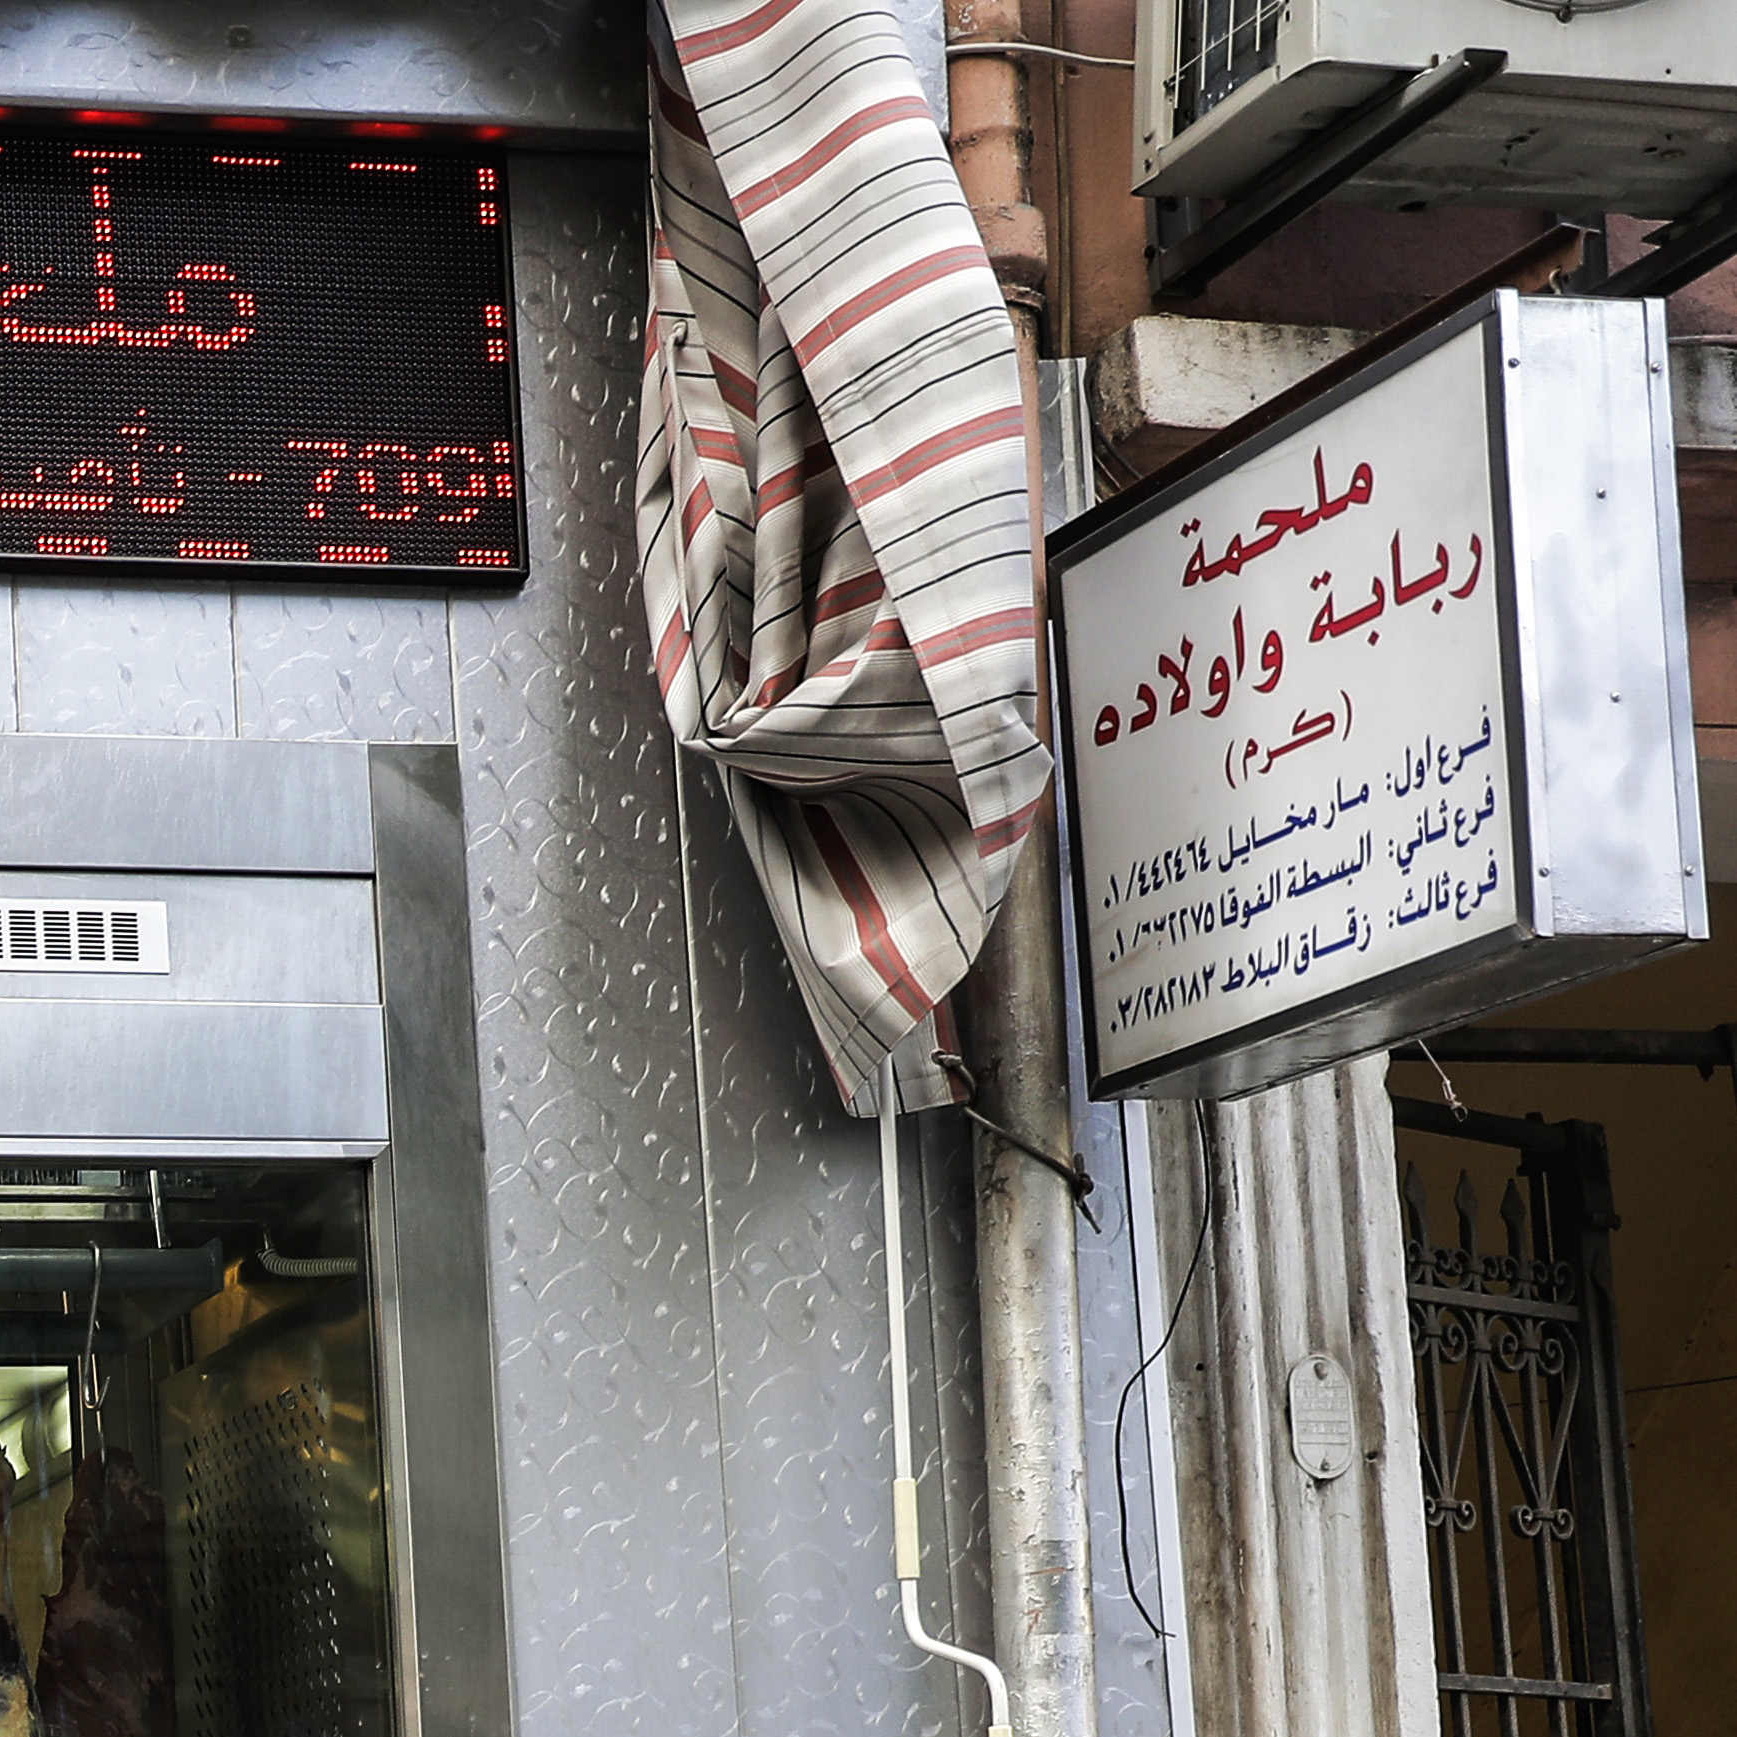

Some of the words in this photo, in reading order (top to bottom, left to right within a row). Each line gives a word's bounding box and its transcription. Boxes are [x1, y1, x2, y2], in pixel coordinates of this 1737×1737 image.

[1179, 444, 1374, 588] ملحمة
[1307, 528, 1483, 647] ربابة
[1224, 689, 1353, 790] (كرم)
[1385, 733, 1432, 798] اول:
[1438, 703, 1492, 786] فرع
[1218, 803, 1317, 874] مخايل
[1322, 776, 1370, 831] مار
[1388, 798, 1449, 877] ثاني:
[1453, 774, 1496, 848] فرع
[1219, 868, 1281, 930] الفوقا
[1286, 829, 1372, 900] البسطة
[1388, 870, 1451, 929] ثالث:
[1454, 848, 1498, 922] فرع
[1220, 932, 1290, 994] البلاط
[1293, 906, 1373, 977] زقاق
